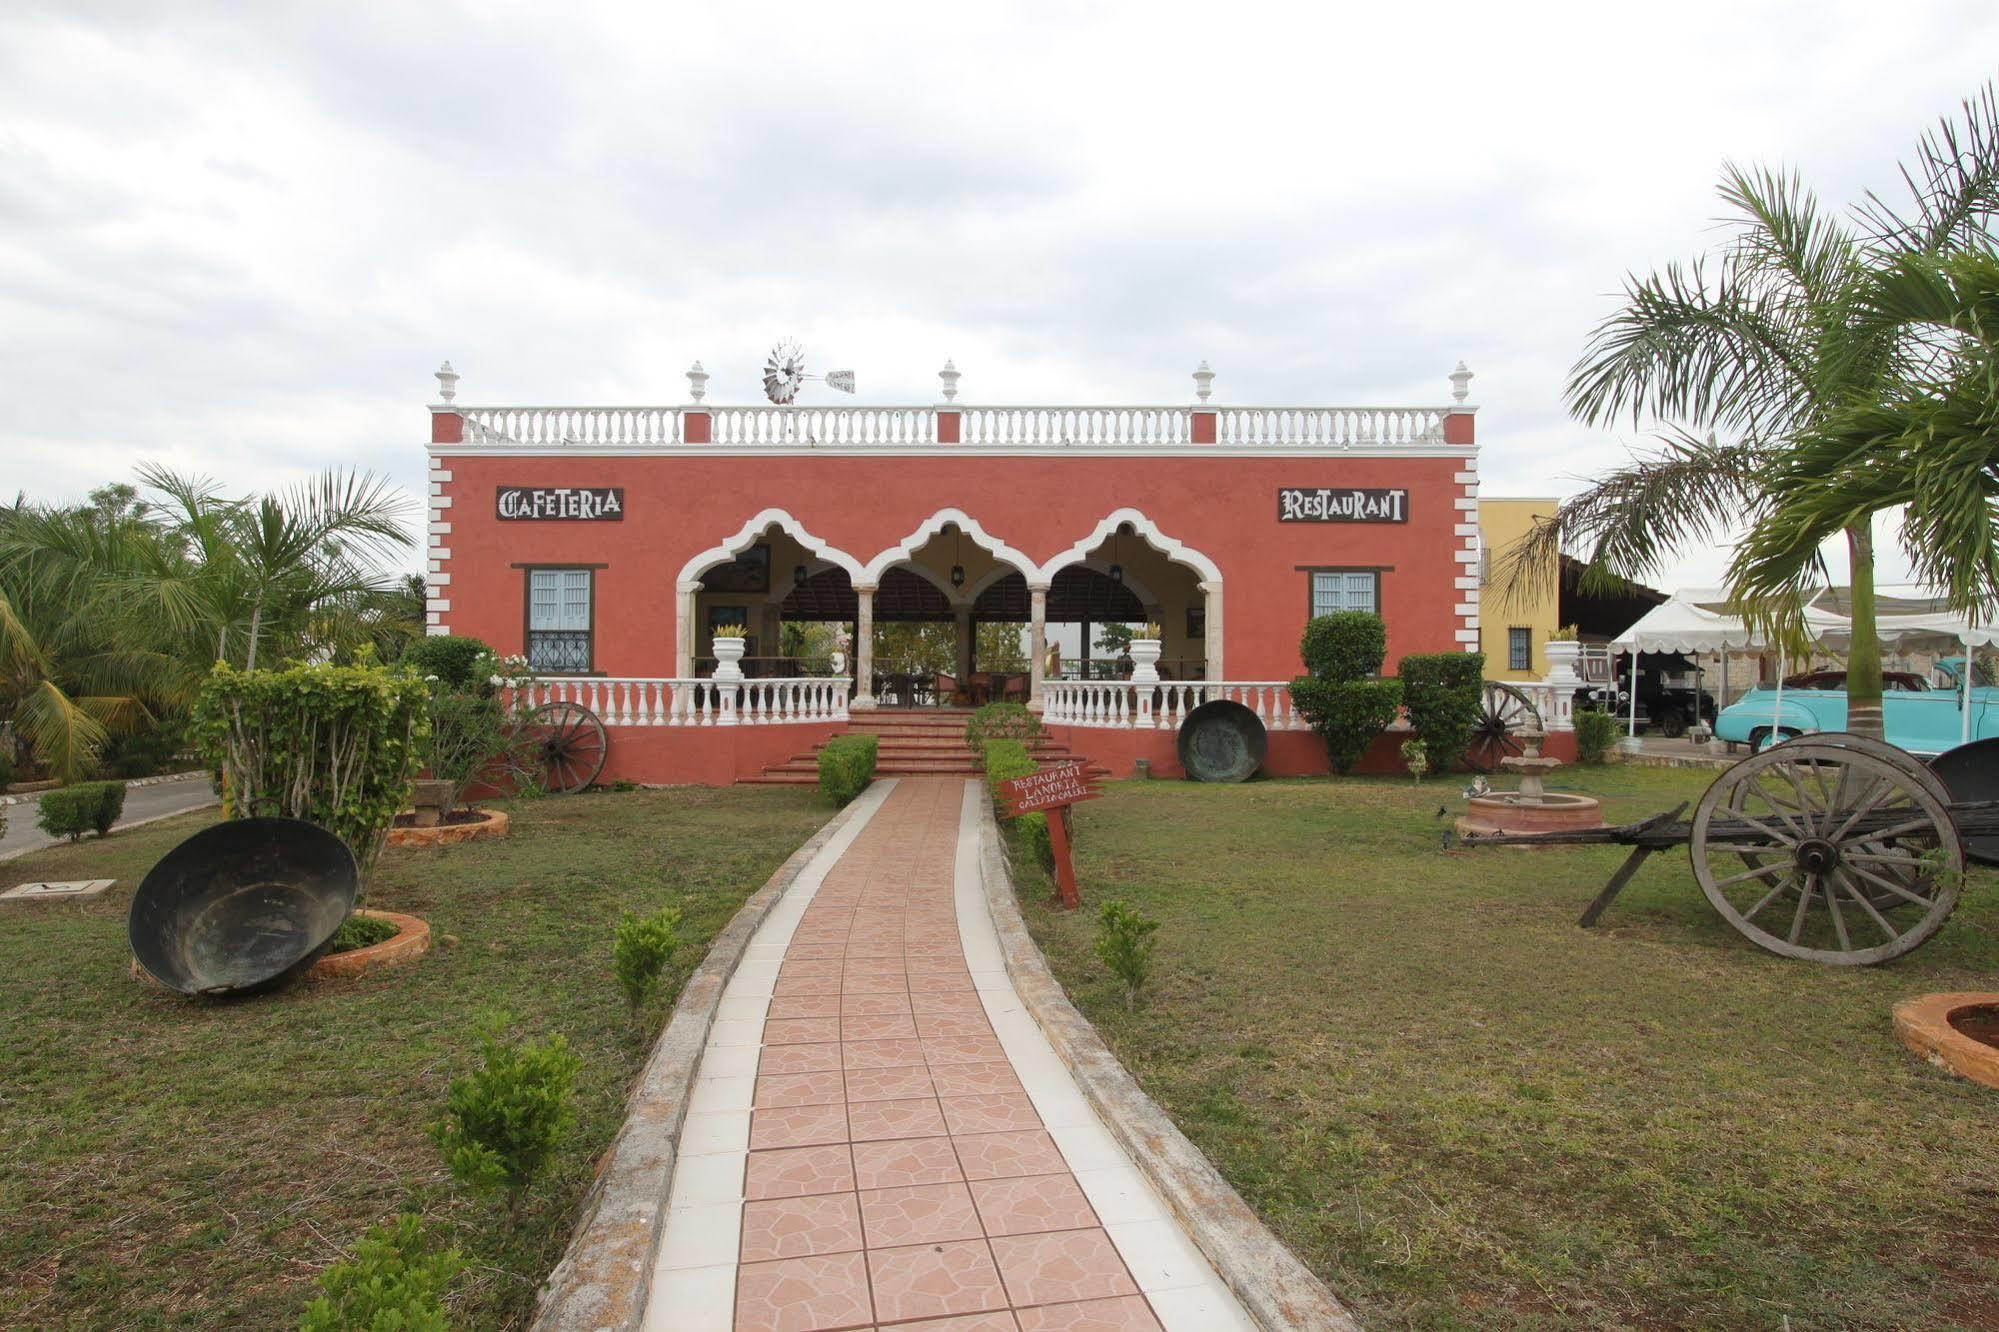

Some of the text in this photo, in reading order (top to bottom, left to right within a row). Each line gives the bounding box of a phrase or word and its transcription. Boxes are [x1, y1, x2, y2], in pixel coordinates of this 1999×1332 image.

[498, 488, 621, 519] CAFETERIA
[1280, 489, 1405, 521] RESTAURANT
[1011, 765, 1081, 792] RESTAURANT
